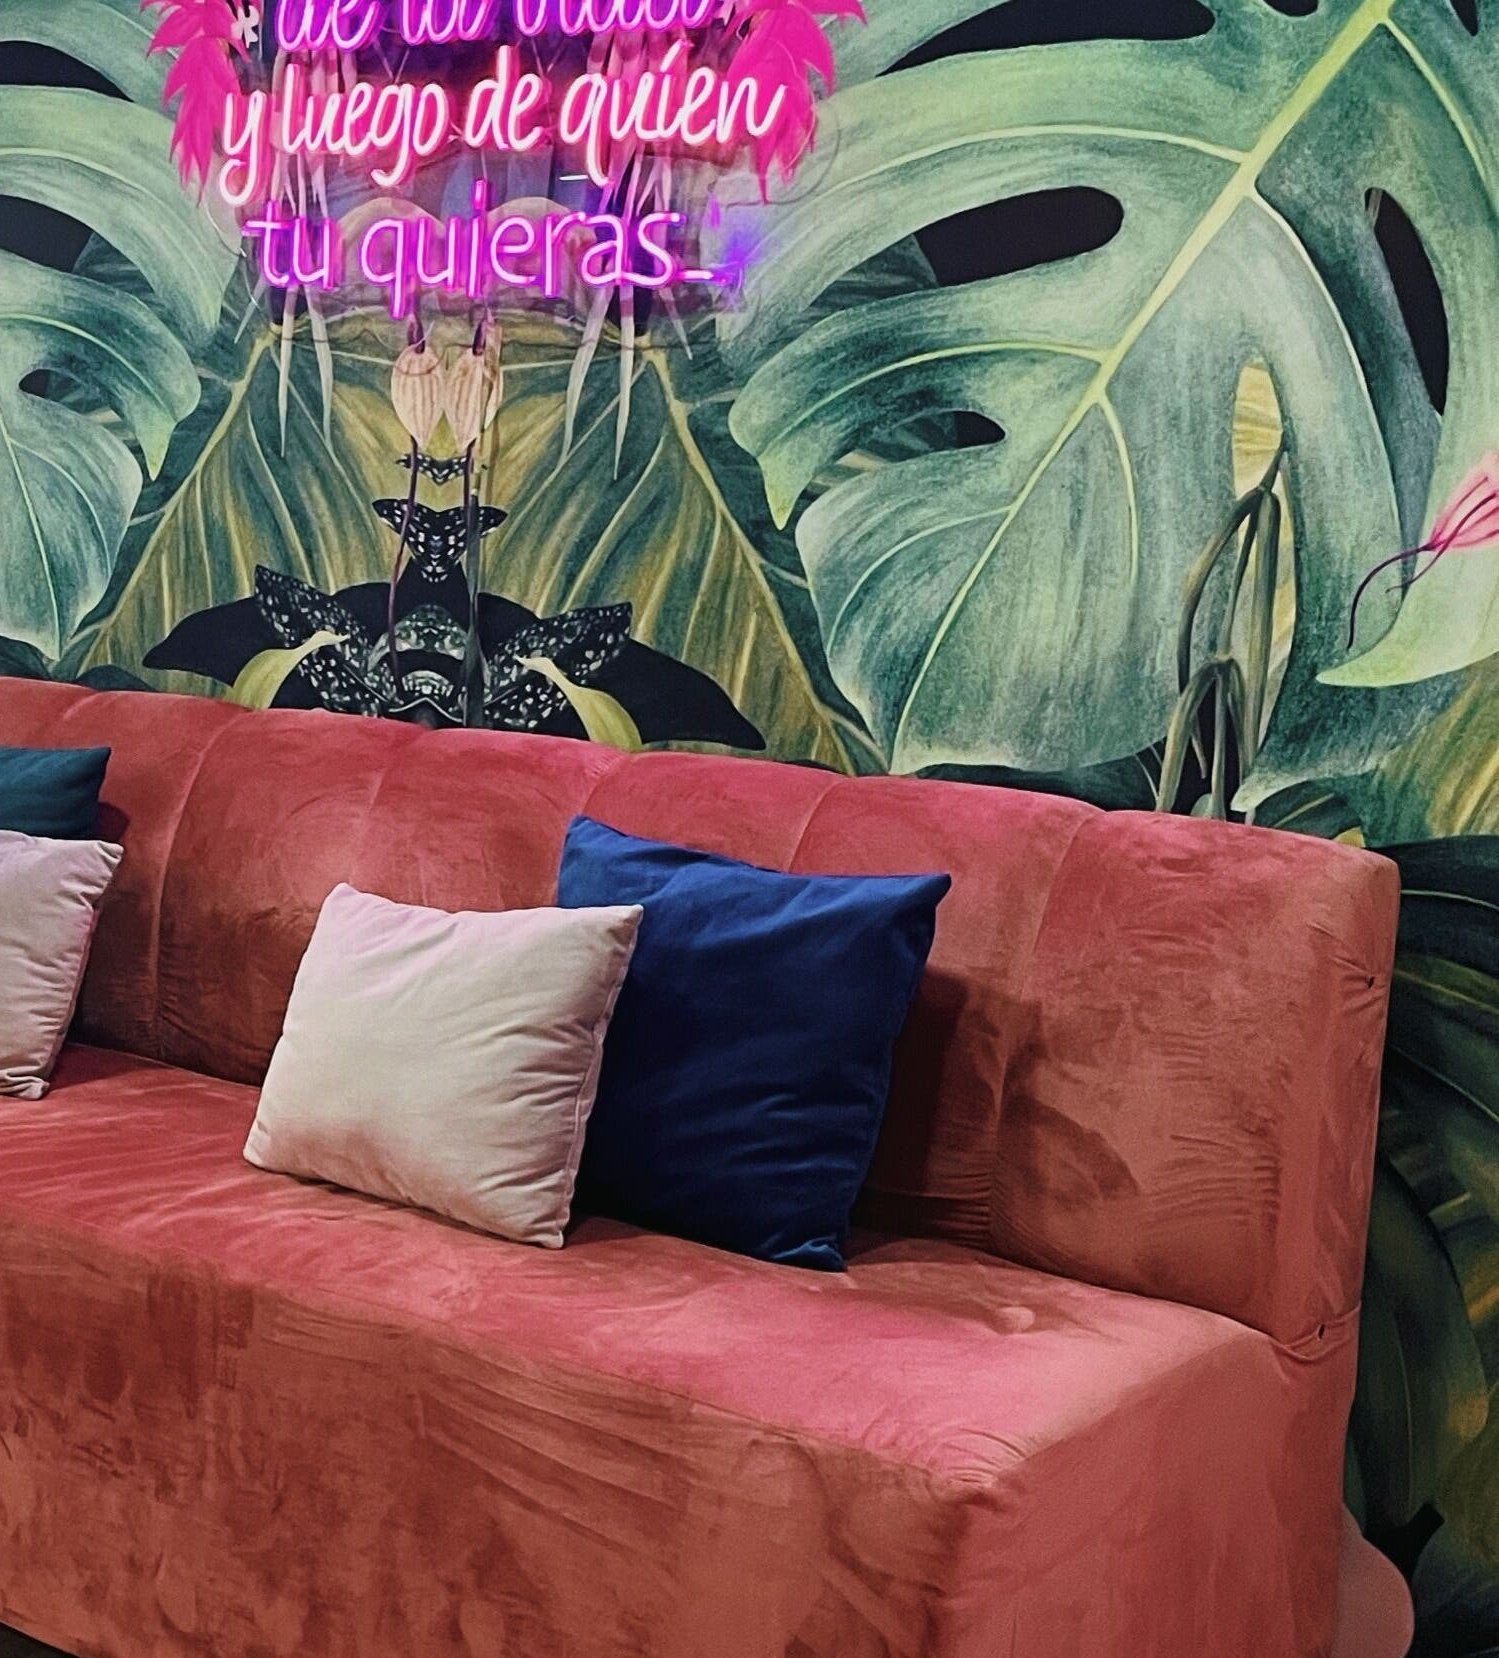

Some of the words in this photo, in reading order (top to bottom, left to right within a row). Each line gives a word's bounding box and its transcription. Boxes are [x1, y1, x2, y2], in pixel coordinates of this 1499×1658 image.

[219, 90, 269, 204] y
[279, 62, 450, 188] luego
[463, 44, 544, 152] de
[241, 199, 338, 290] tu
[359, 178, 686, 319] quieras
